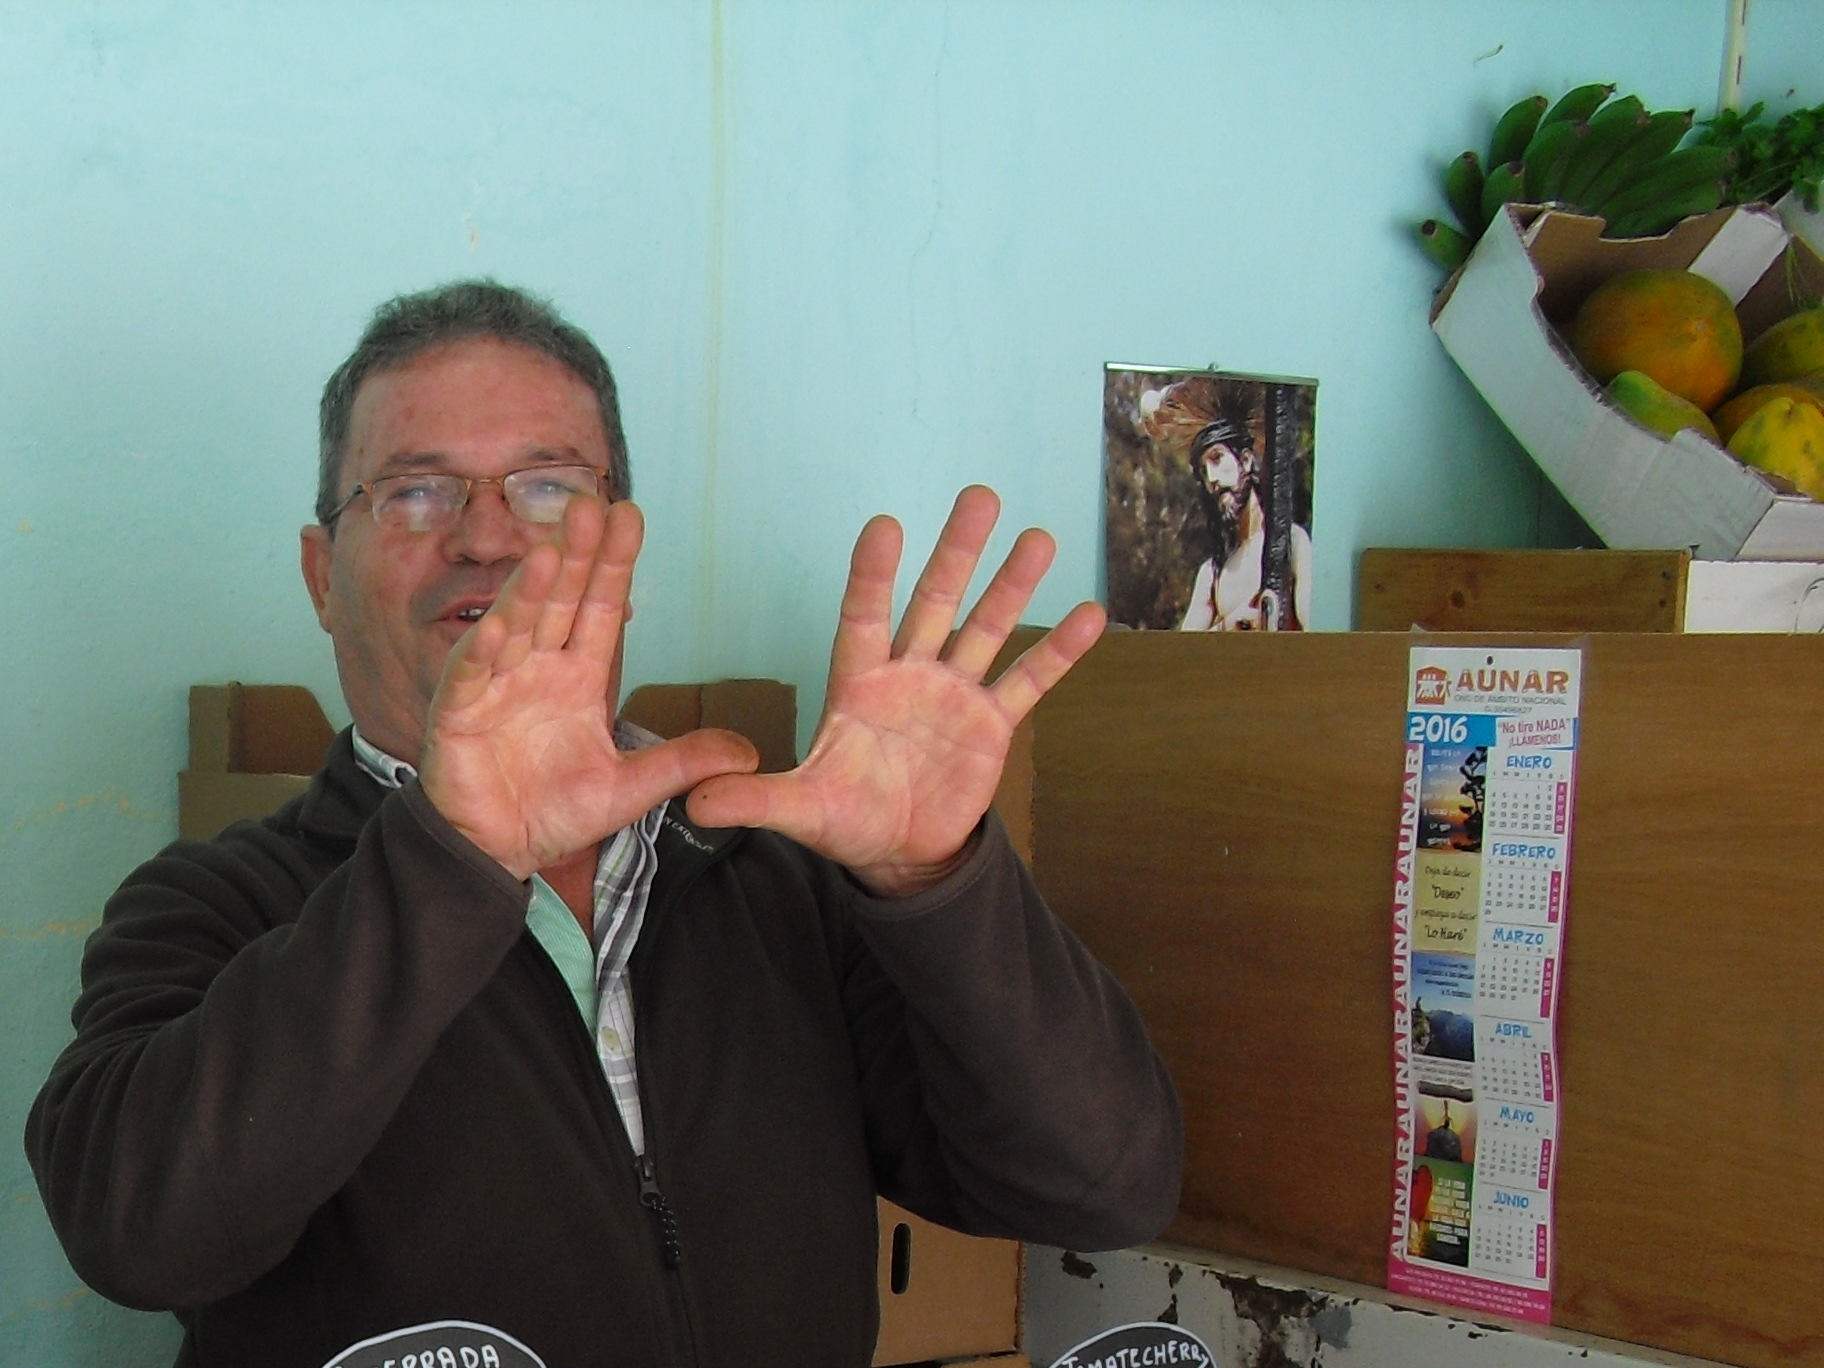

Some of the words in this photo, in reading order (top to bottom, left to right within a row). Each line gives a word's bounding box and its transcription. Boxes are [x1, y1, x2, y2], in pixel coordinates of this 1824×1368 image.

[1457, 669, 1569, 694] AUNAR
[1409, 715, 1469, 743] 2016
[1507, 755, 1552, 770] ENERO
[1492, 842, 1557, 860] FEBRERO
[1493, 927, 1544, 945] MARZO
[1495, 1023, 1532, 1038] ABRIL
[1500, 1106, 1534, 1123] MAYO
[1493, 1191, 1529, 1208] JUNIO
